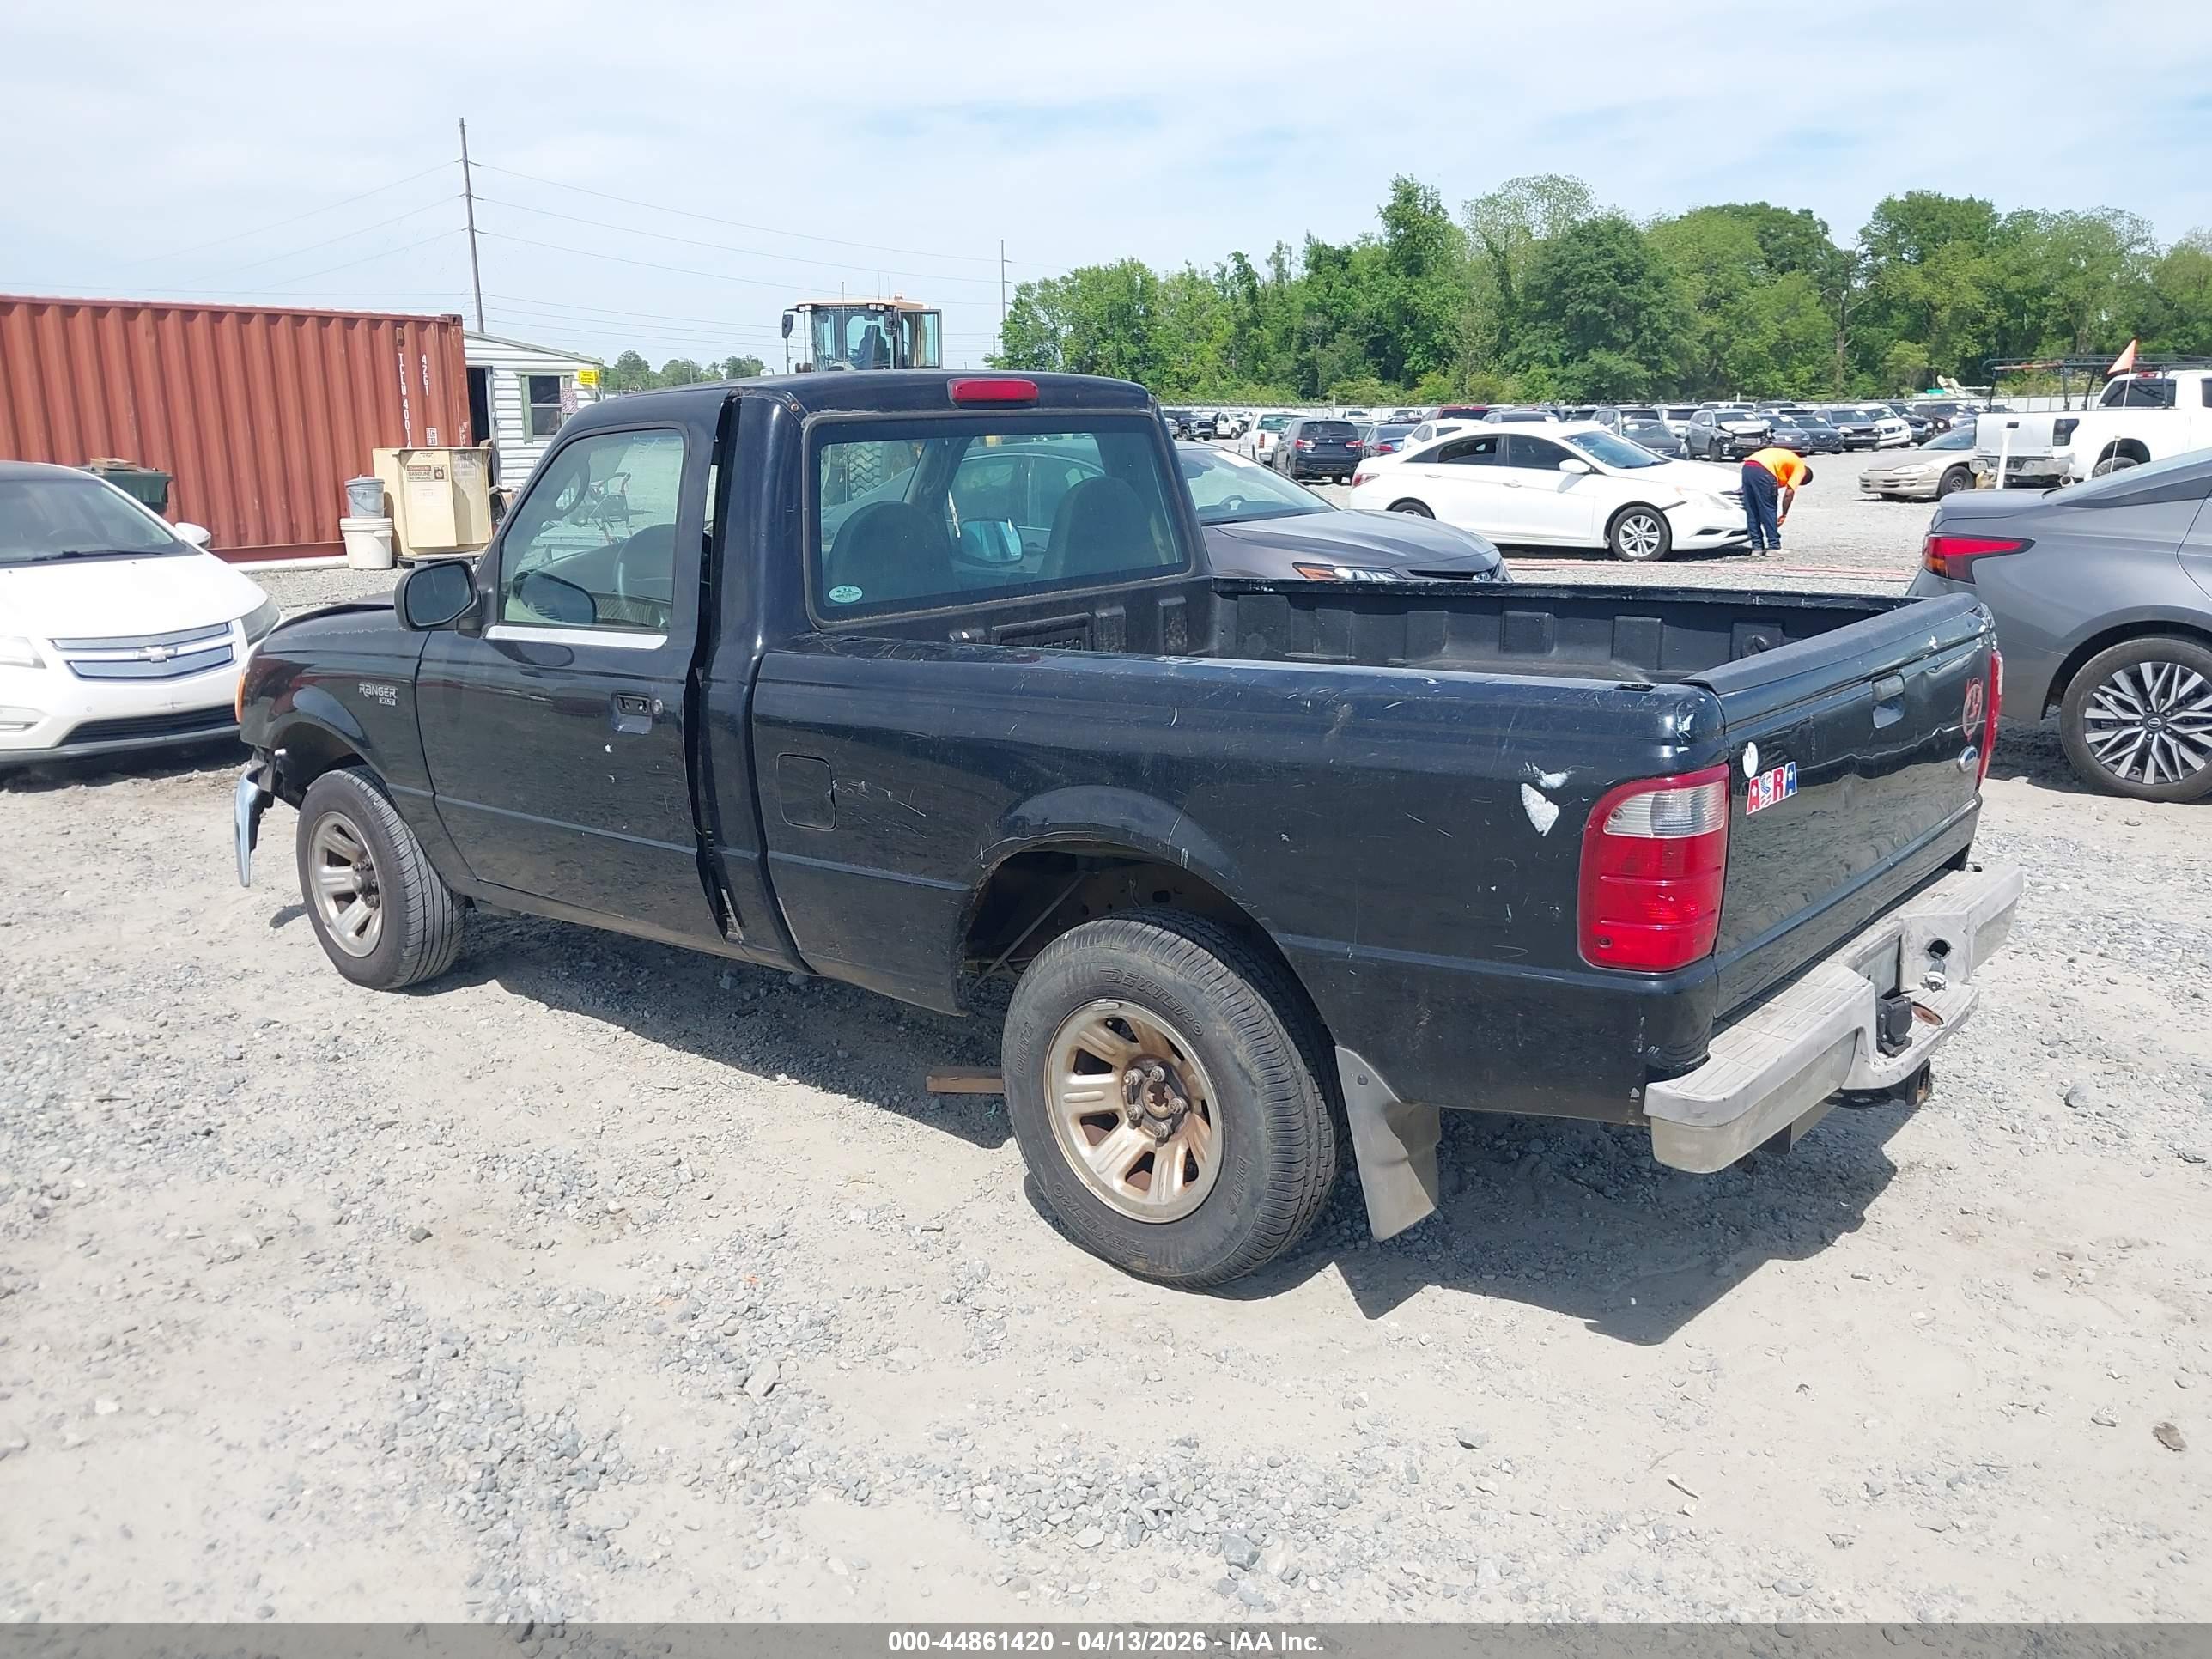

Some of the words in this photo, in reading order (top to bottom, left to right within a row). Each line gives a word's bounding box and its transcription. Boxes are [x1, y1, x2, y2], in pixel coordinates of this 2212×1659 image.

[398, 353, 407, 396] TCLU
[421, 353, 429, 396] 42G1
[358, 683, 397, 699] RANGER
